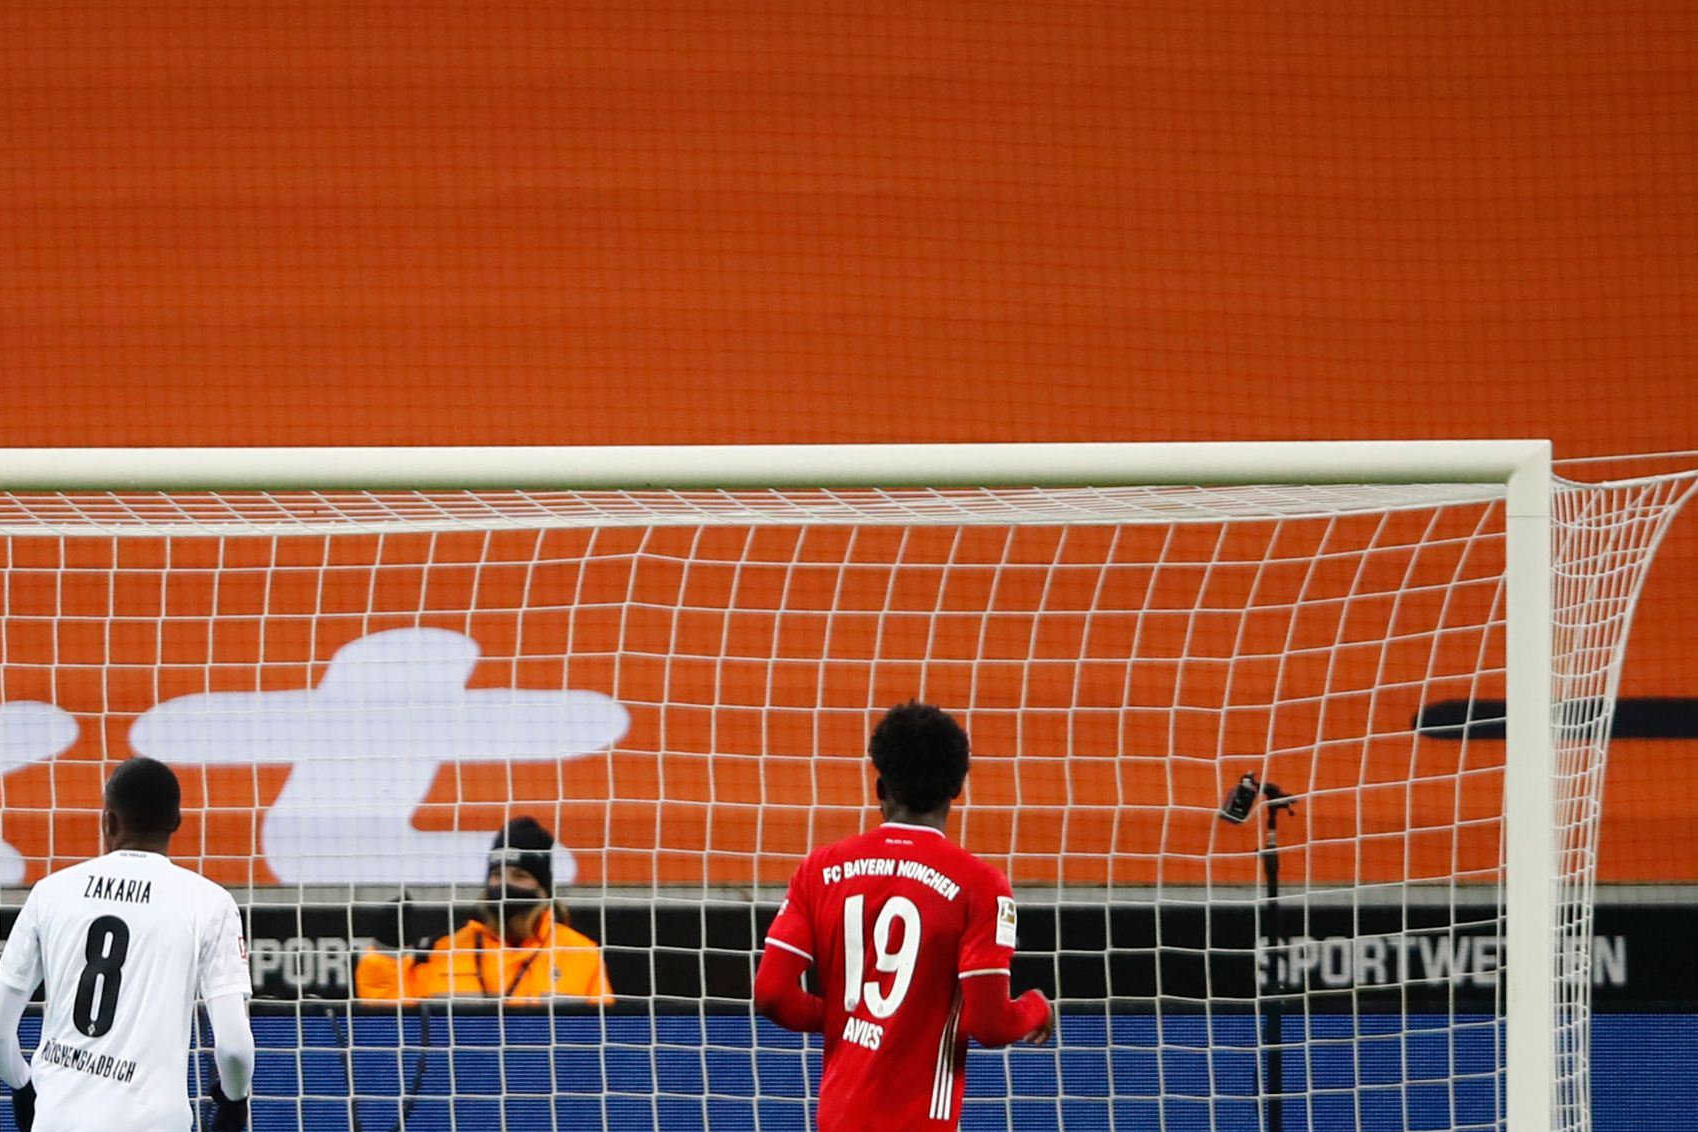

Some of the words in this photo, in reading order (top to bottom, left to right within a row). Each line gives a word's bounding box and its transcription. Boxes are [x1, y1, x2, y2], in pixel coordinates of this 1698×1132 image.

[84, 875, 152, 904] ZAKARIA
[823, 865, 842, 885] FC
[843, 859, 896, 878] BAYERN
[844, 894, 921, 1019] 19
[73, 914, 130, 1038] 8
[842, 1016, 884, 1051] AVIES
